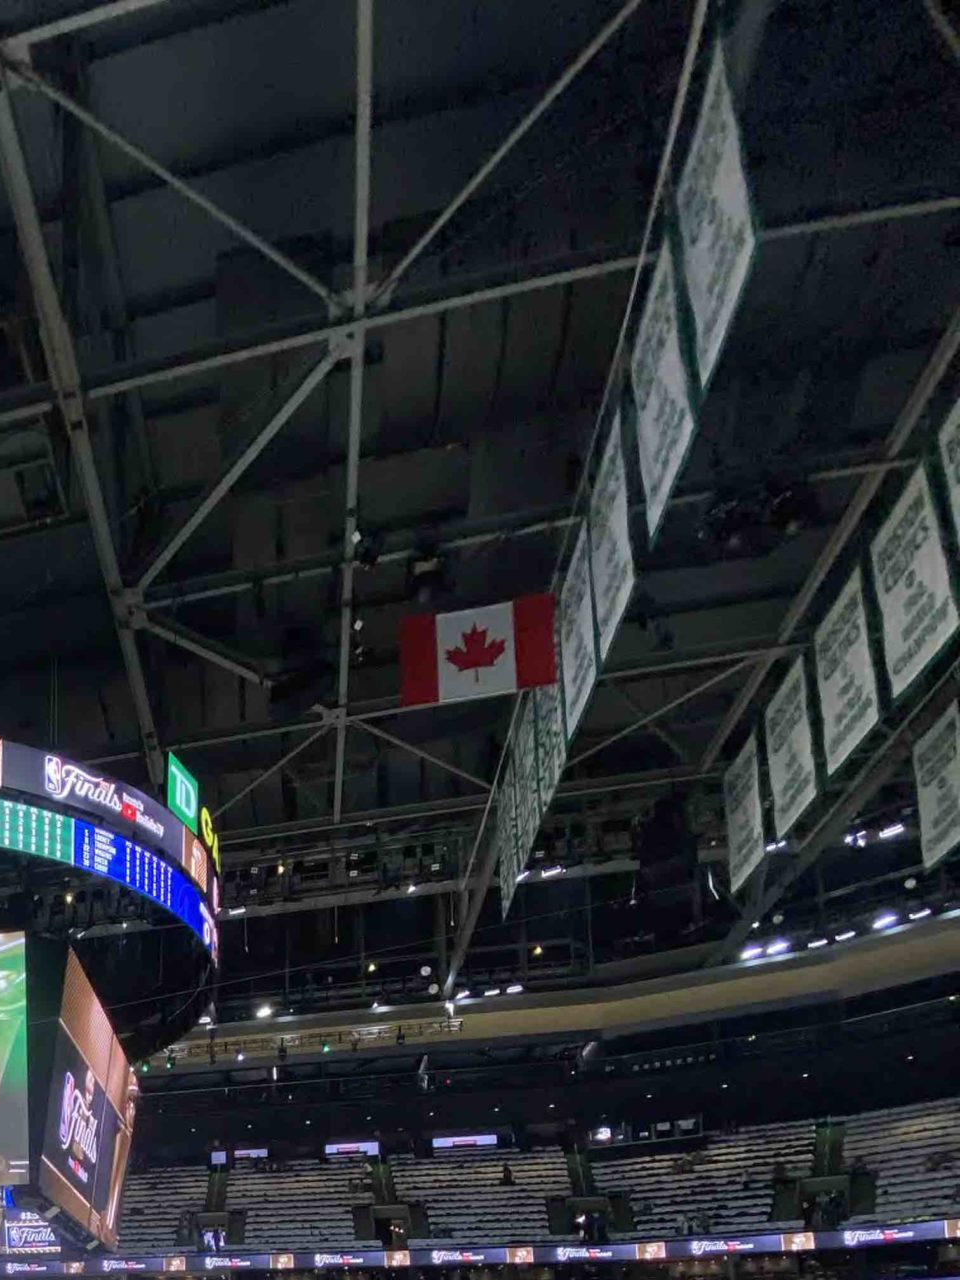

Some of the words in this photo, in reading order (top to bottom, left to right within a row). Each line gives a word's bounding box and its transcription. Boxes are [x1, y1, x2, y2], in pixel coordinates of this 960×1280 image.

[52, 765, 122, 811] Finals
[171, 765, 196, 818] TD
[62, 1088, 98, 1164] Finals
[17, 1227, 56, 1247] Finals
